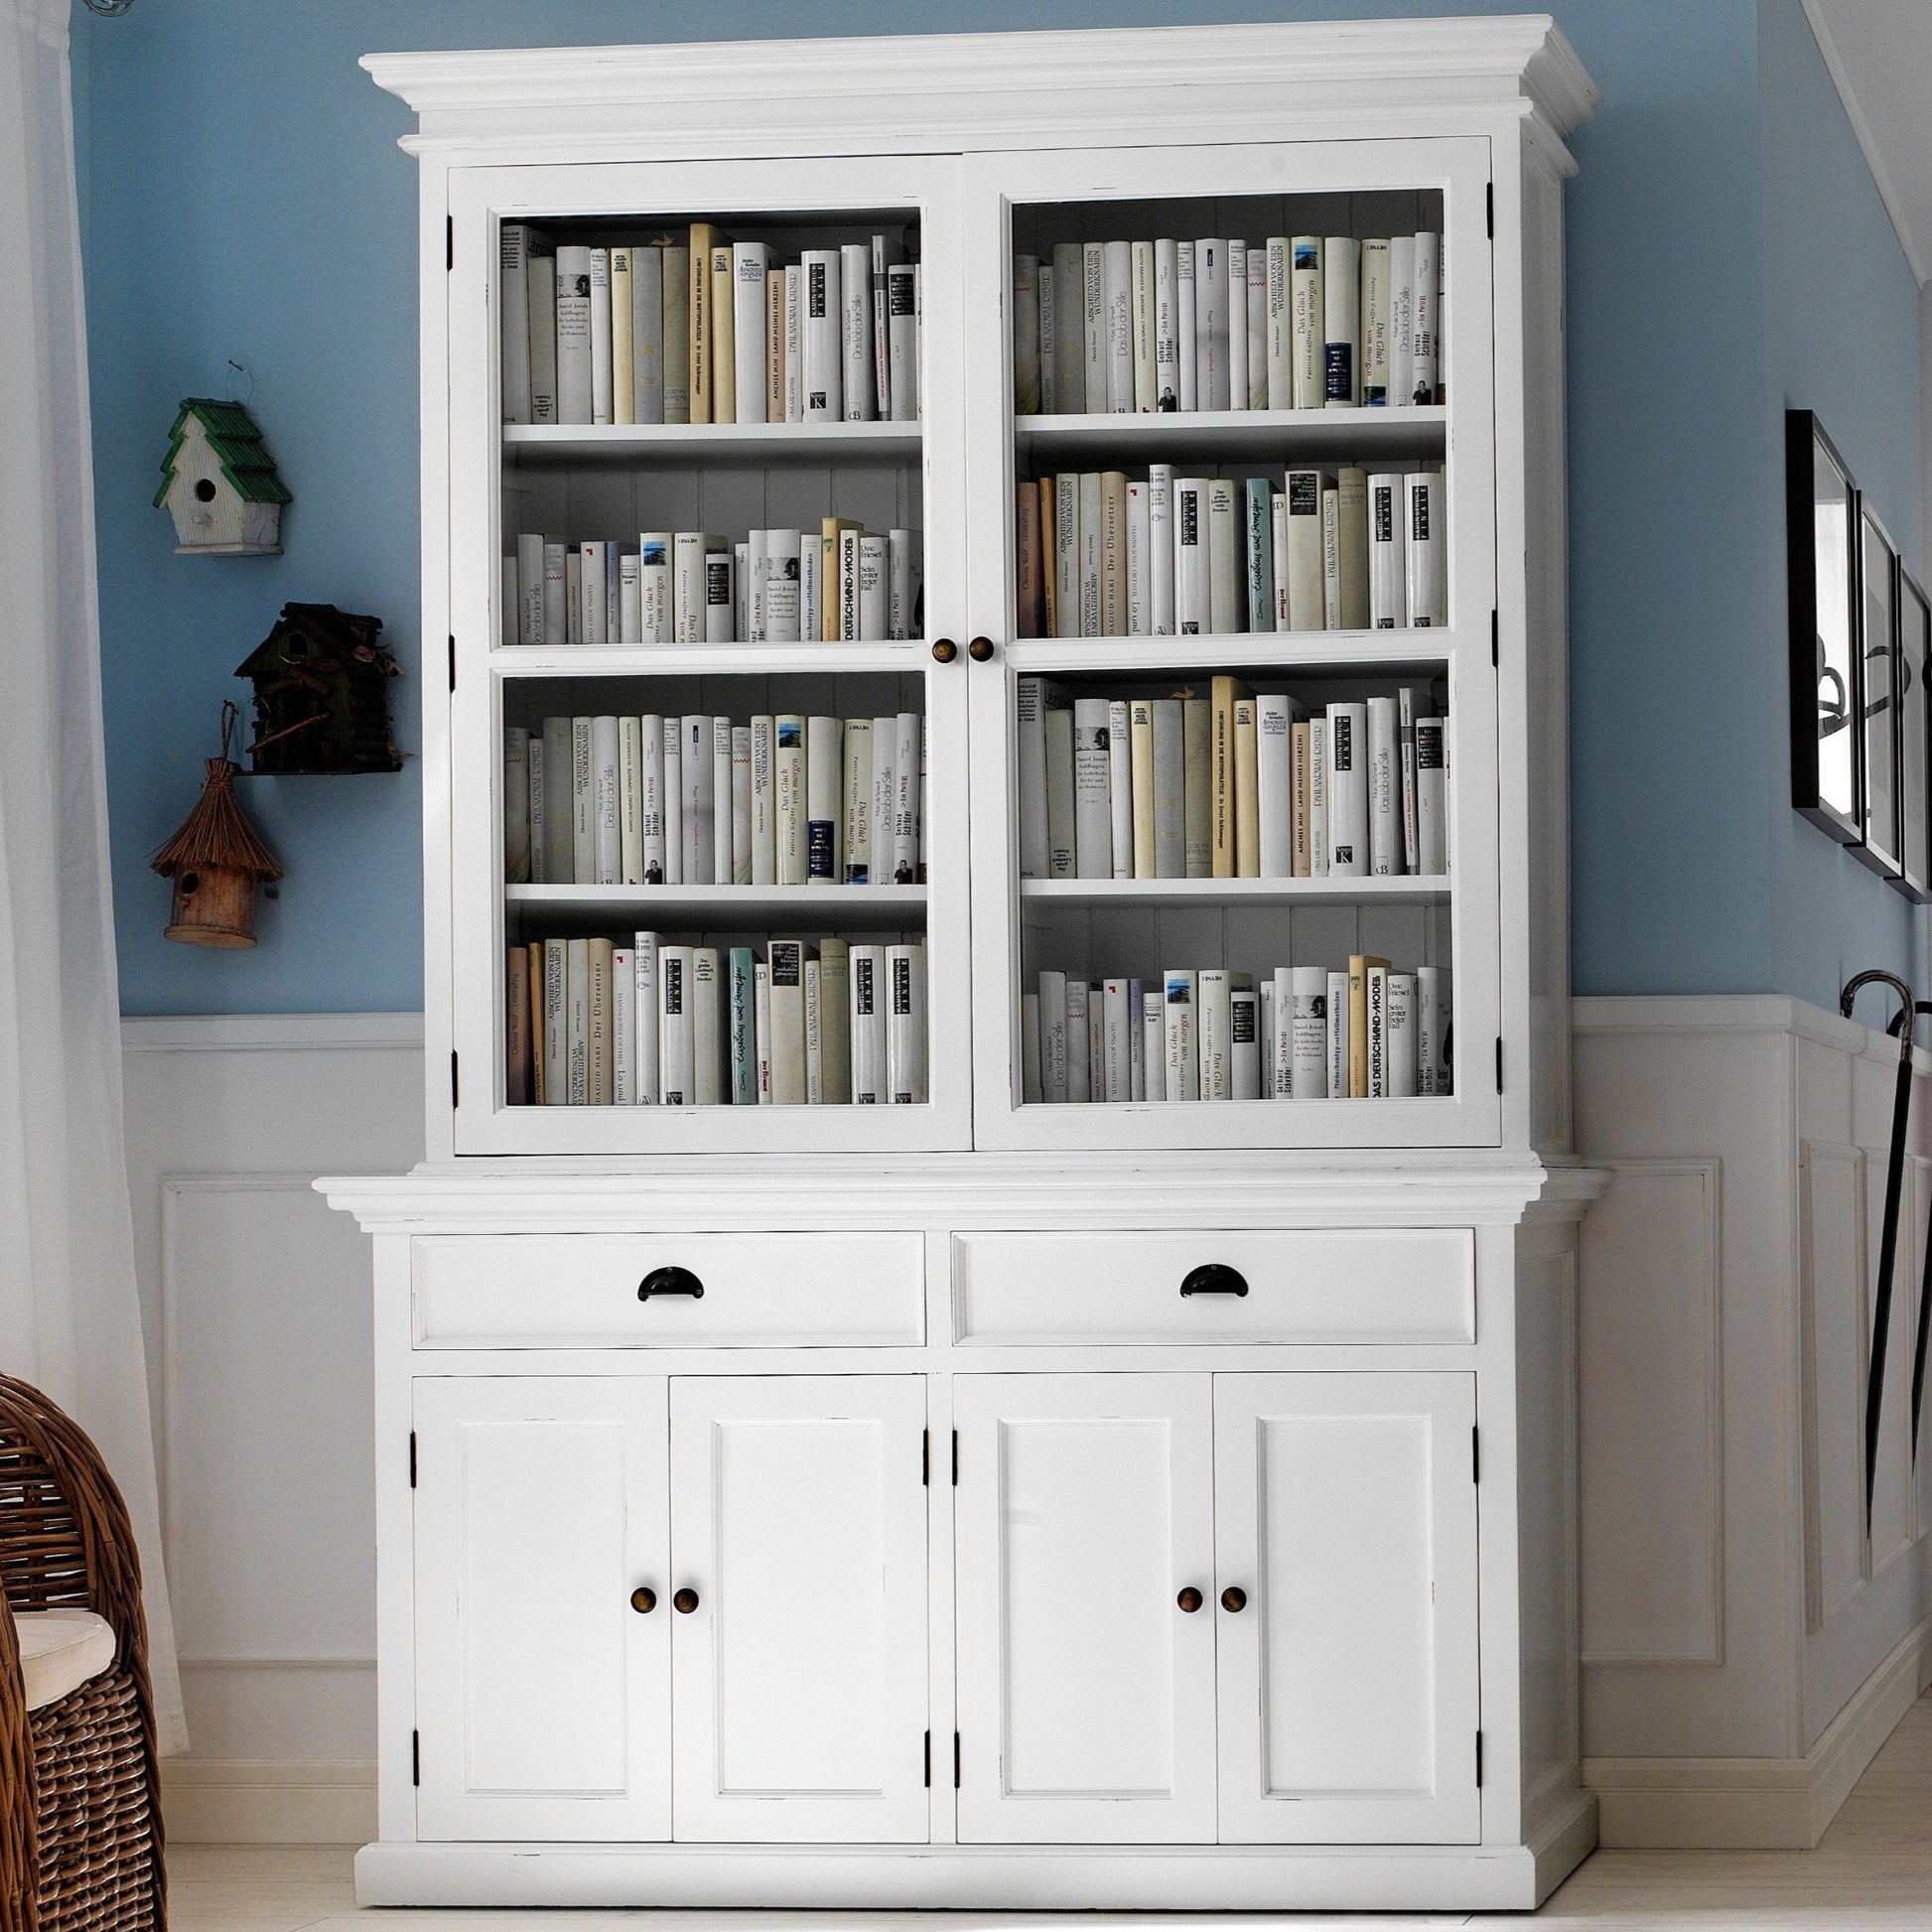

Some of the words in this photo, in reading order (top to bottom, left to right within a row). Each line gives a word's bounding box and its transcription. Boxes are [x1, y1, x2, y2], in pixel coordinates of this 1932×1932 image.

[1252, 534, 1261, 550] und
[792, 759, 801, 787] morgen
[1372, 1081, 1381, 1097] DAS
